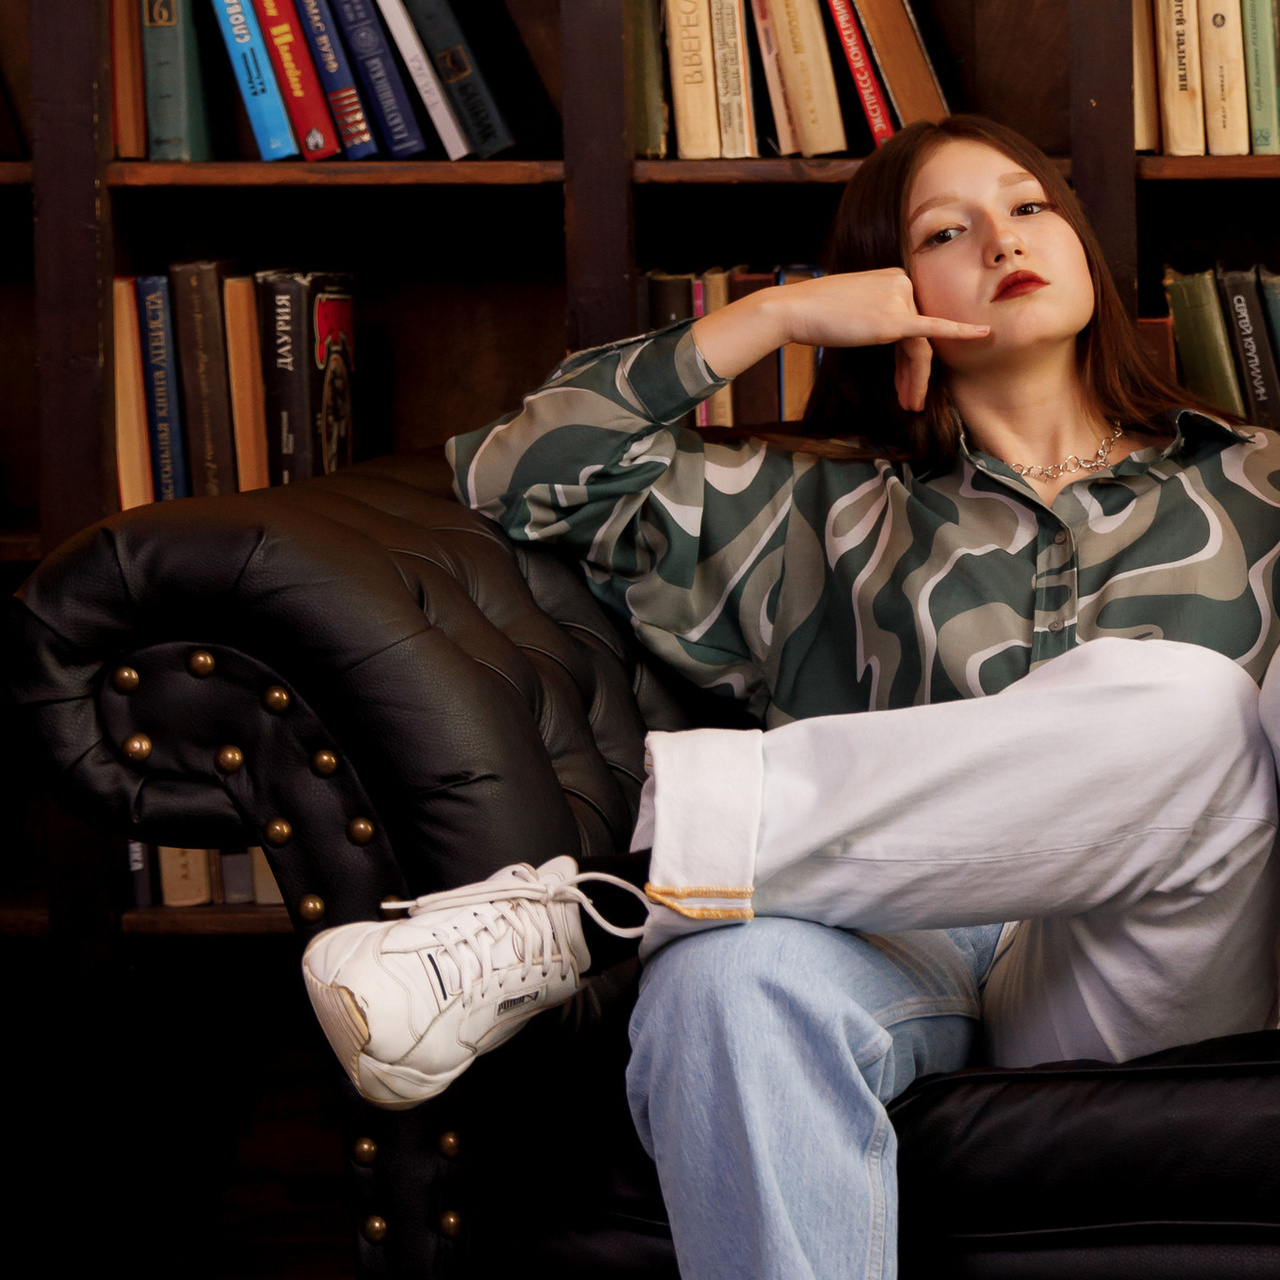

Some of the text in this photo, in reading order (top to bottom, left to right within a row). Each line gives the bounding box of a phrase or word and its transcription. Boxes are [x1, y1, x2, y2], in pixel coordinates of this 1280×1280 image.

[314, 33, 340, 74] ВУЛФ
[1175, 29, 1189, 91] залыгин
[274, 293, 294, 371] ДАУРИЯ
[1231, 293, 1267, 402] СЕРГЕЙ КРУТИЛИН
[144, 290, 175, 500] астольная книга АТЕИСТА
